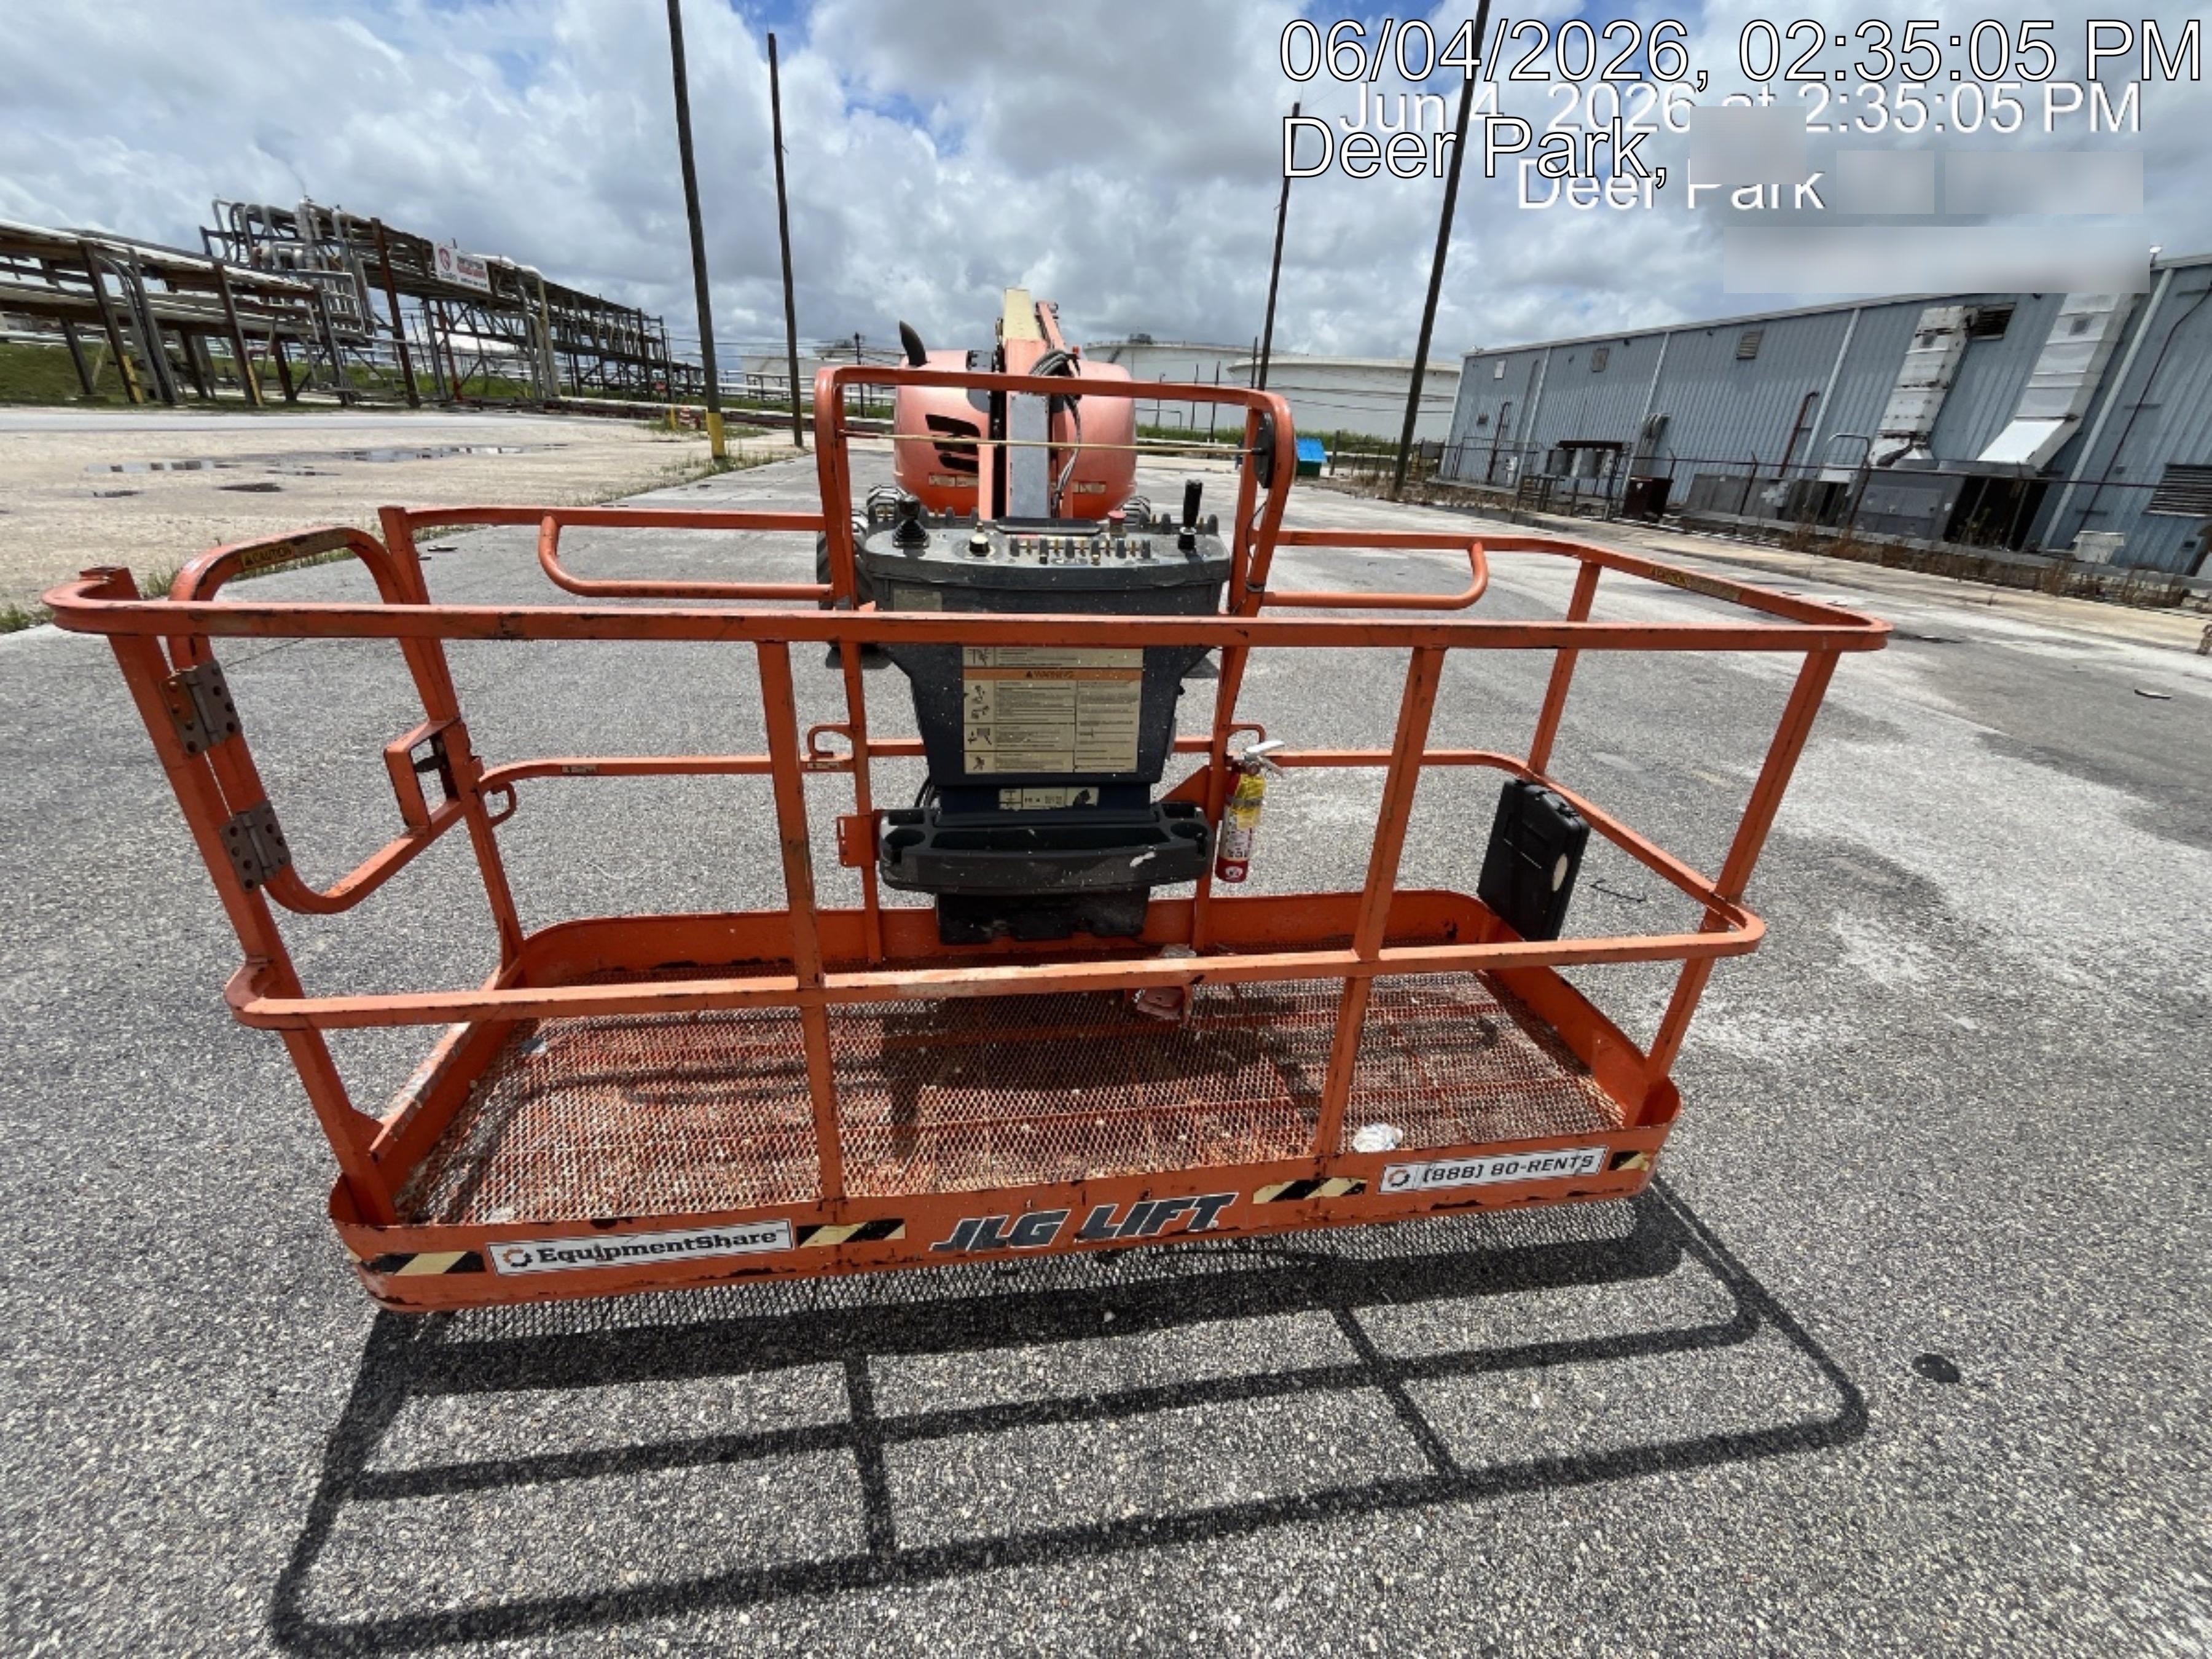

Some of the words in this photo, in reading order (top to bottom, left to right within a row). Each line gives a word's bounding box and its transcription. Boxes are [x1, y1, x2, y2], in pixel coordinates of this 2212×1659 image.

[1422, 1164, 1484, 1183] (888)
[1491, 1155, 1594, 1176] 80-RENTS
[928, 1209, 1072, 1252] JLG
[1075, 1192, 1239, 1243] LIFT
[536, 1232, 777, 1264] EquipmentShare
